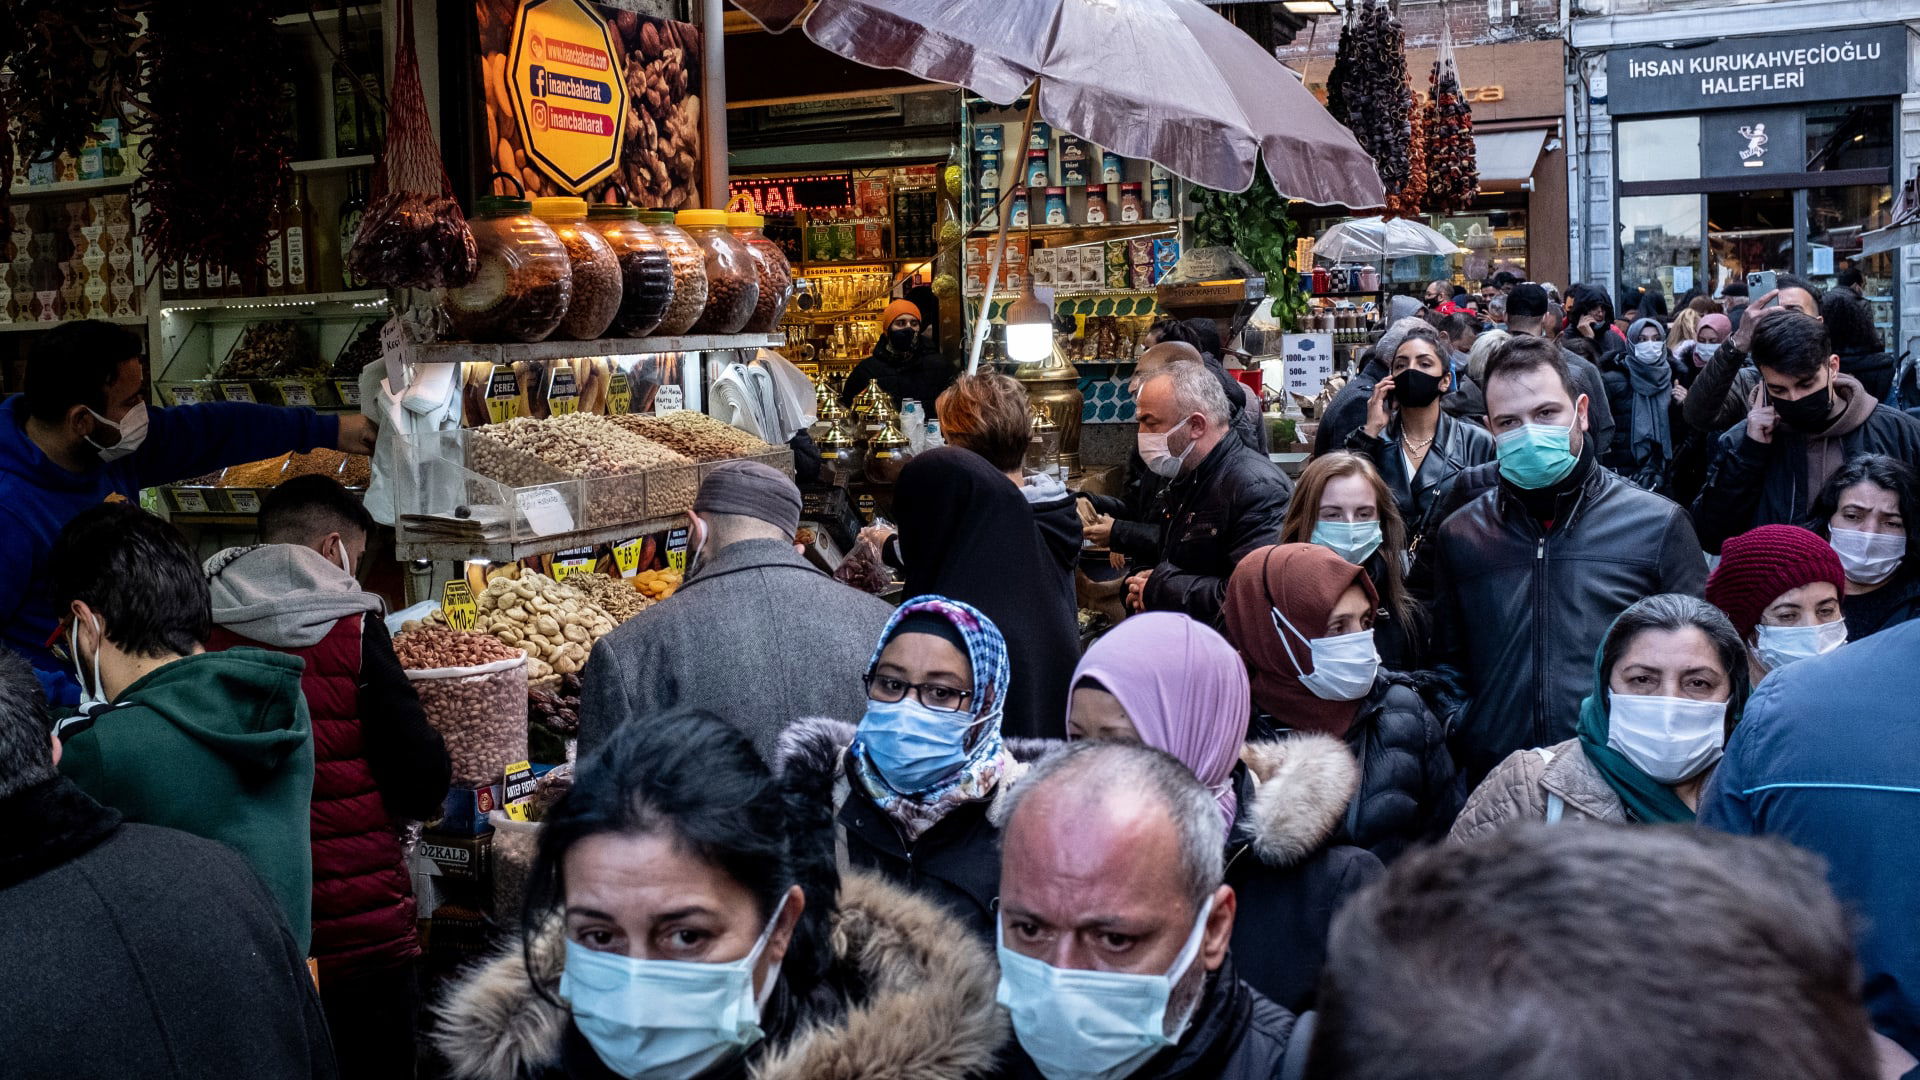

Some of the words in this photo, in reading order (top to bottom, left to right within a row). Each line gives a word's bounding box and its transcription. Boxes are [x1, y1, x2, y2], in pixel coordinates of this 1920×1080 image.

[547, 44, 608, 70] www.inancbaharat.com
[1629, 59, 1684, 79] İHSAN
[1690, 42, 1881, 74] KURUKAHVECİOĞLU
[548, 75, 602, 101] inancbaharat
[1701, 68, 1805, 95] HALEFLERİ
[550, 110, 604, 134] inancbaharat
[493, 383, 515, 395] ÇEREZ
[499, 401, 509, 420] 70
[624, 547, 633, 565] 65
[675, 551, 683, 569] 65
